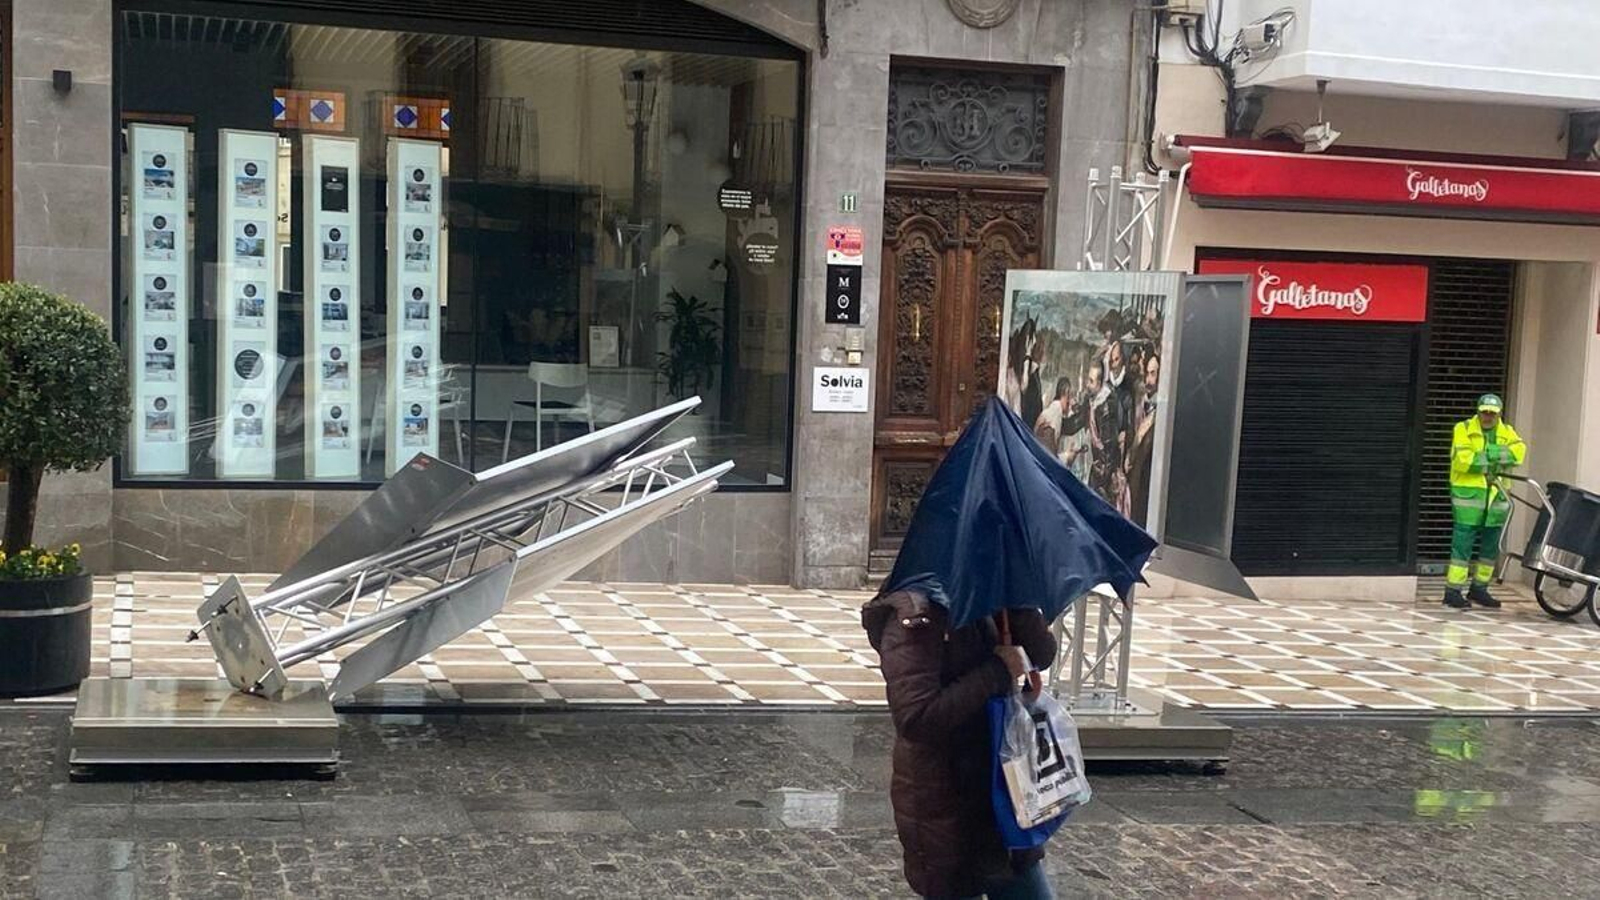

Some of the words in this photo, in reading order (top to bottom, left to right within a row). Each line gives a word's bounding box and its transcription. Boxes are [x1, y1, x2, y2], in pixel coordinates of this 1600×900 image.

[842, 195, 856, 211] 11
[1257, 265, 1373, 315] Galletanas
[820, 374, 863, 388] Solvia
